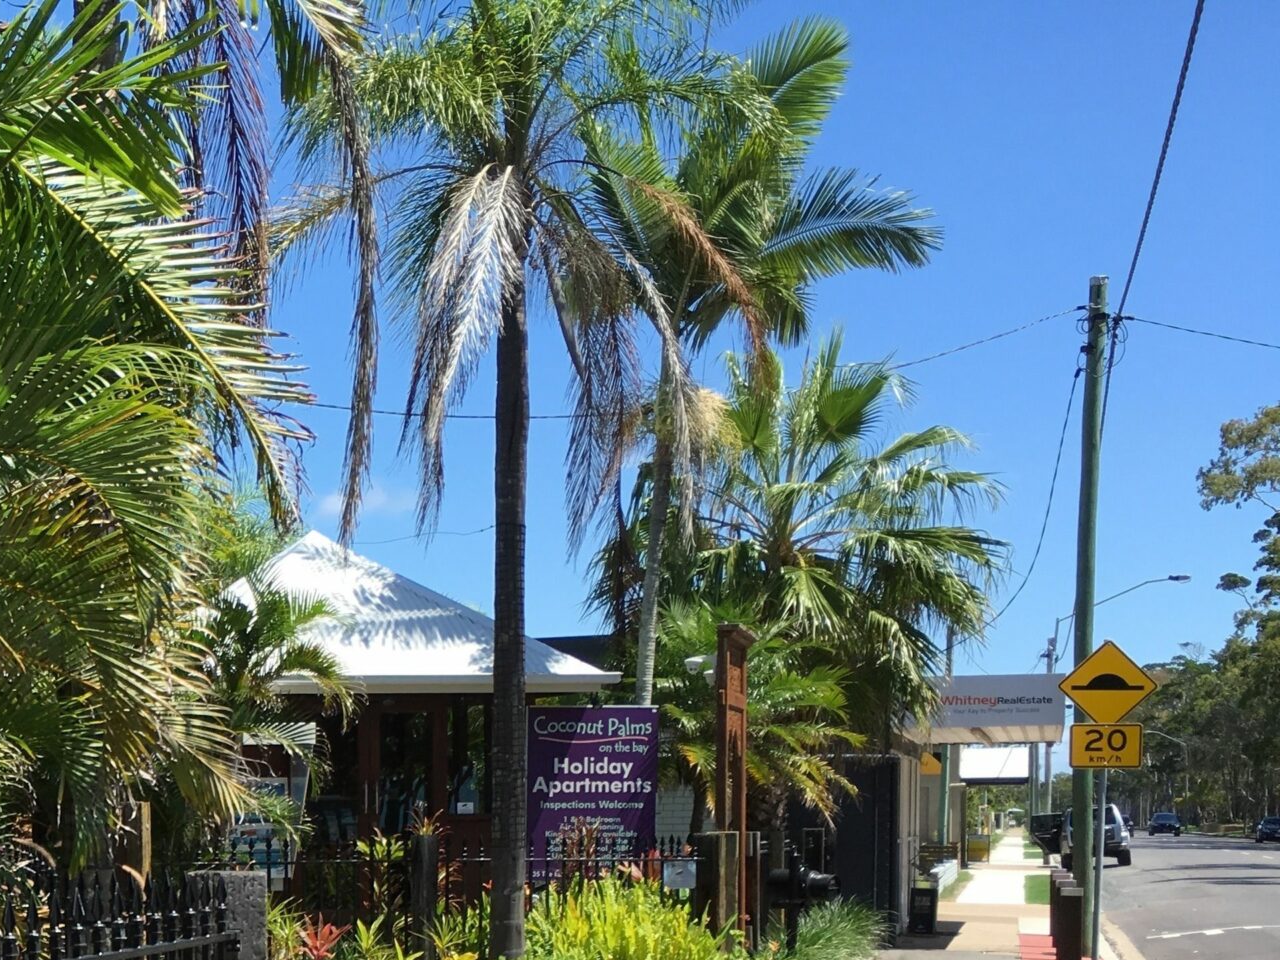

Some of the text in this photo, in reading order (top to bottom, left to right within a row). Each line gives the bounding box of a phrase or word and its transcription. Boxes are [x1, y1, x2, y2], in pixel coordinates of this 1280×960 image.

[534, 716, 652, 737] Coconut Palms
[599, 741, 649, 755] on the bay
[1085, 729, 1127, 752] 20
[554, 757, 633, 779] Holiday
[1089, 755, 1122, 763] km/h
[533, 777, 652, 797] Apartments
[540, 800, 644, 811] Inspections Welcome
